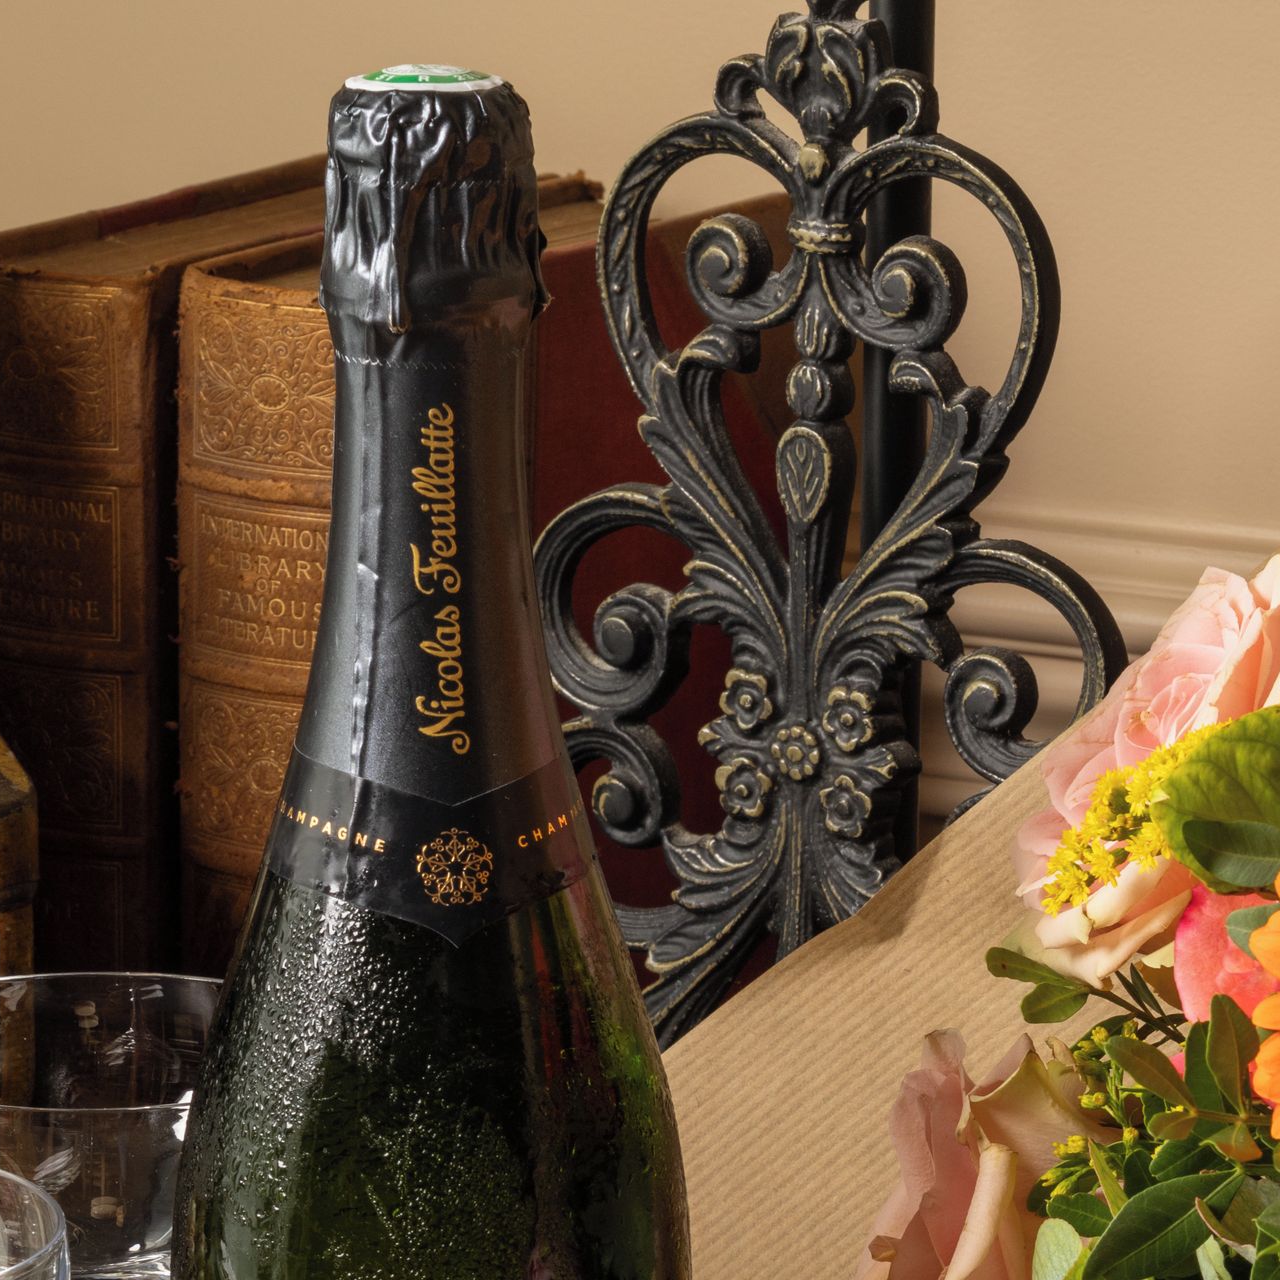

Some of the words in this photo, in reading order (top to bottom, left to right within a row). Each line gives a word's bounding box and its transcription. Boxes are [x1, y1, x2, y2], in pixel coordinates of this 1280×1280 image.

[410, 402, 462, 595] Feuillatte
[199, 512, 329, 552] INTERNATION
[255, 577, 281, 594] OF
[417, 603, 471, 756] Nicolas
[279, 799, 387, 854] HAMPAGNE
